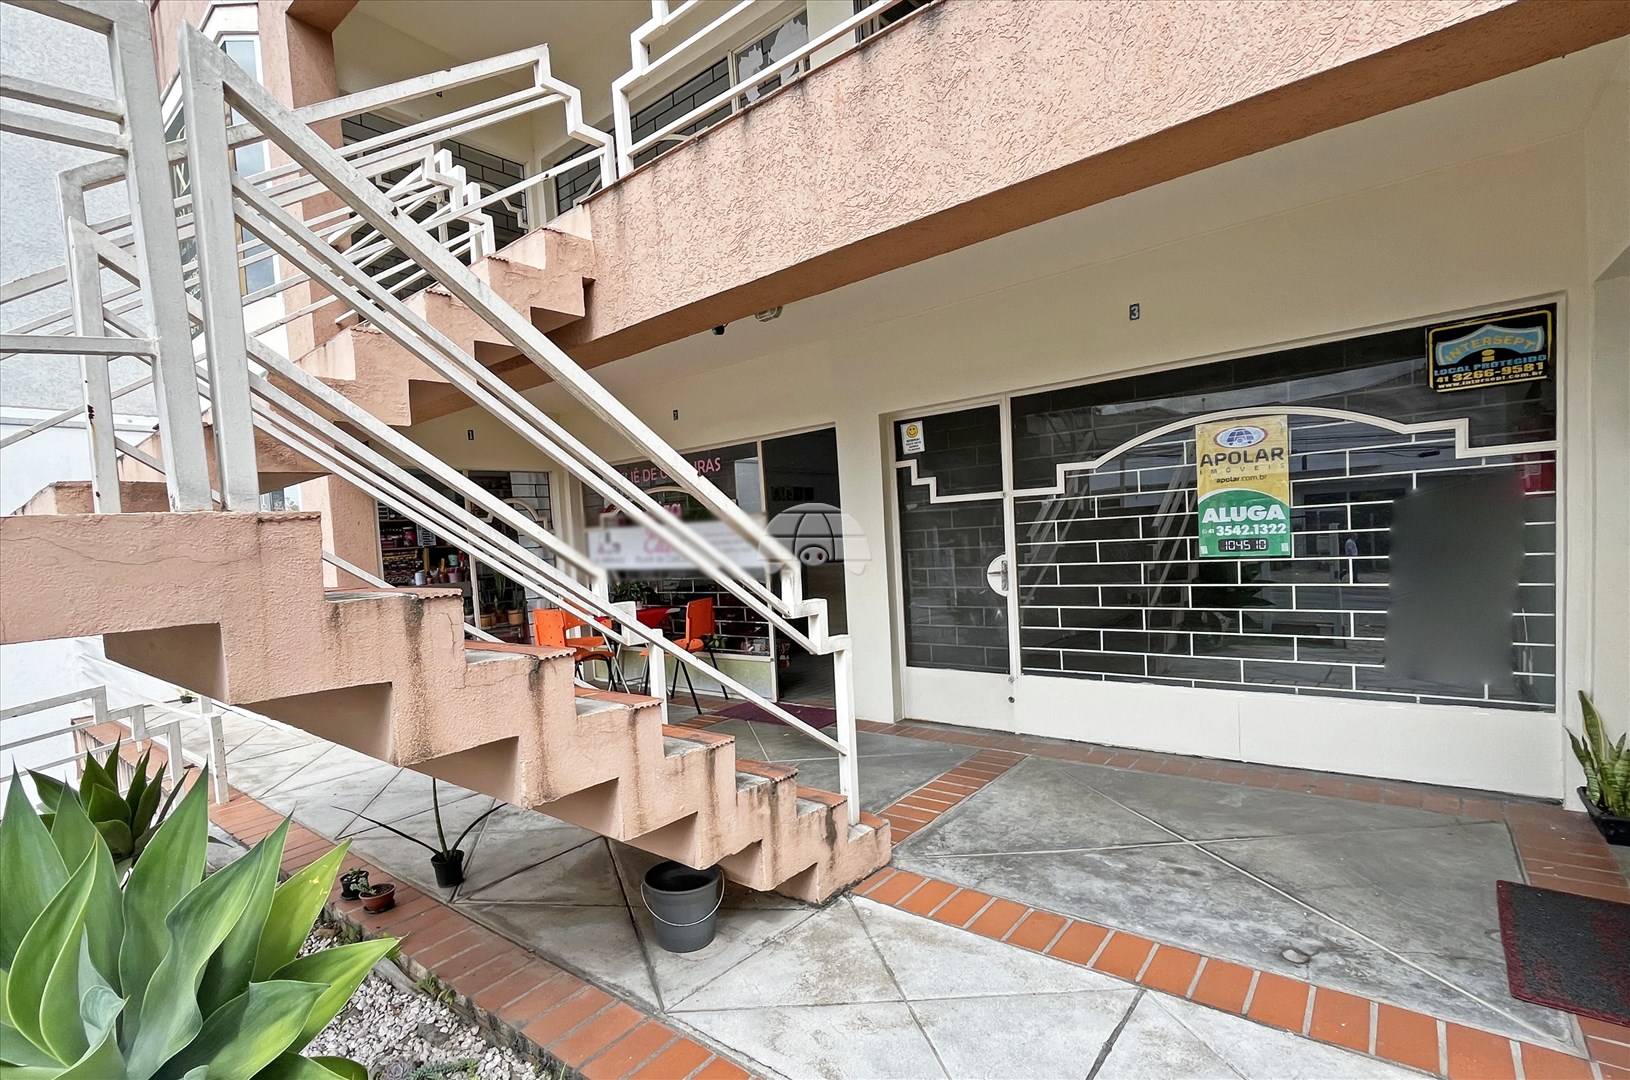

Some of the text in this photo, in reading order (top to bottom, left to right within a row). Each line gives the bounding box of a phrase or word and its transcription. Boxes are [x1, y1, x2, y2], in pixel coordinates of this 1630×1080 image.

[1130, 305, 1139, 319] 3
[1445, 336, 1536, 361] INTERSEPT
[1434, 354, 1546, 376] LOCAL PROTEGIDO
[1452, 362, 1544, 382] 3266-9581
[1438, 371, 1543, 389] www.intersept.com.br
[1200, 447, 1284, 468] APOLAR
[642, 467, 657, 482] DE
[1216, 474, 1267, 484] apolar.com.br
[1202, 504, 1286, 523] ALUGA
[1216, 523, 1287, 536] 3542.1322
